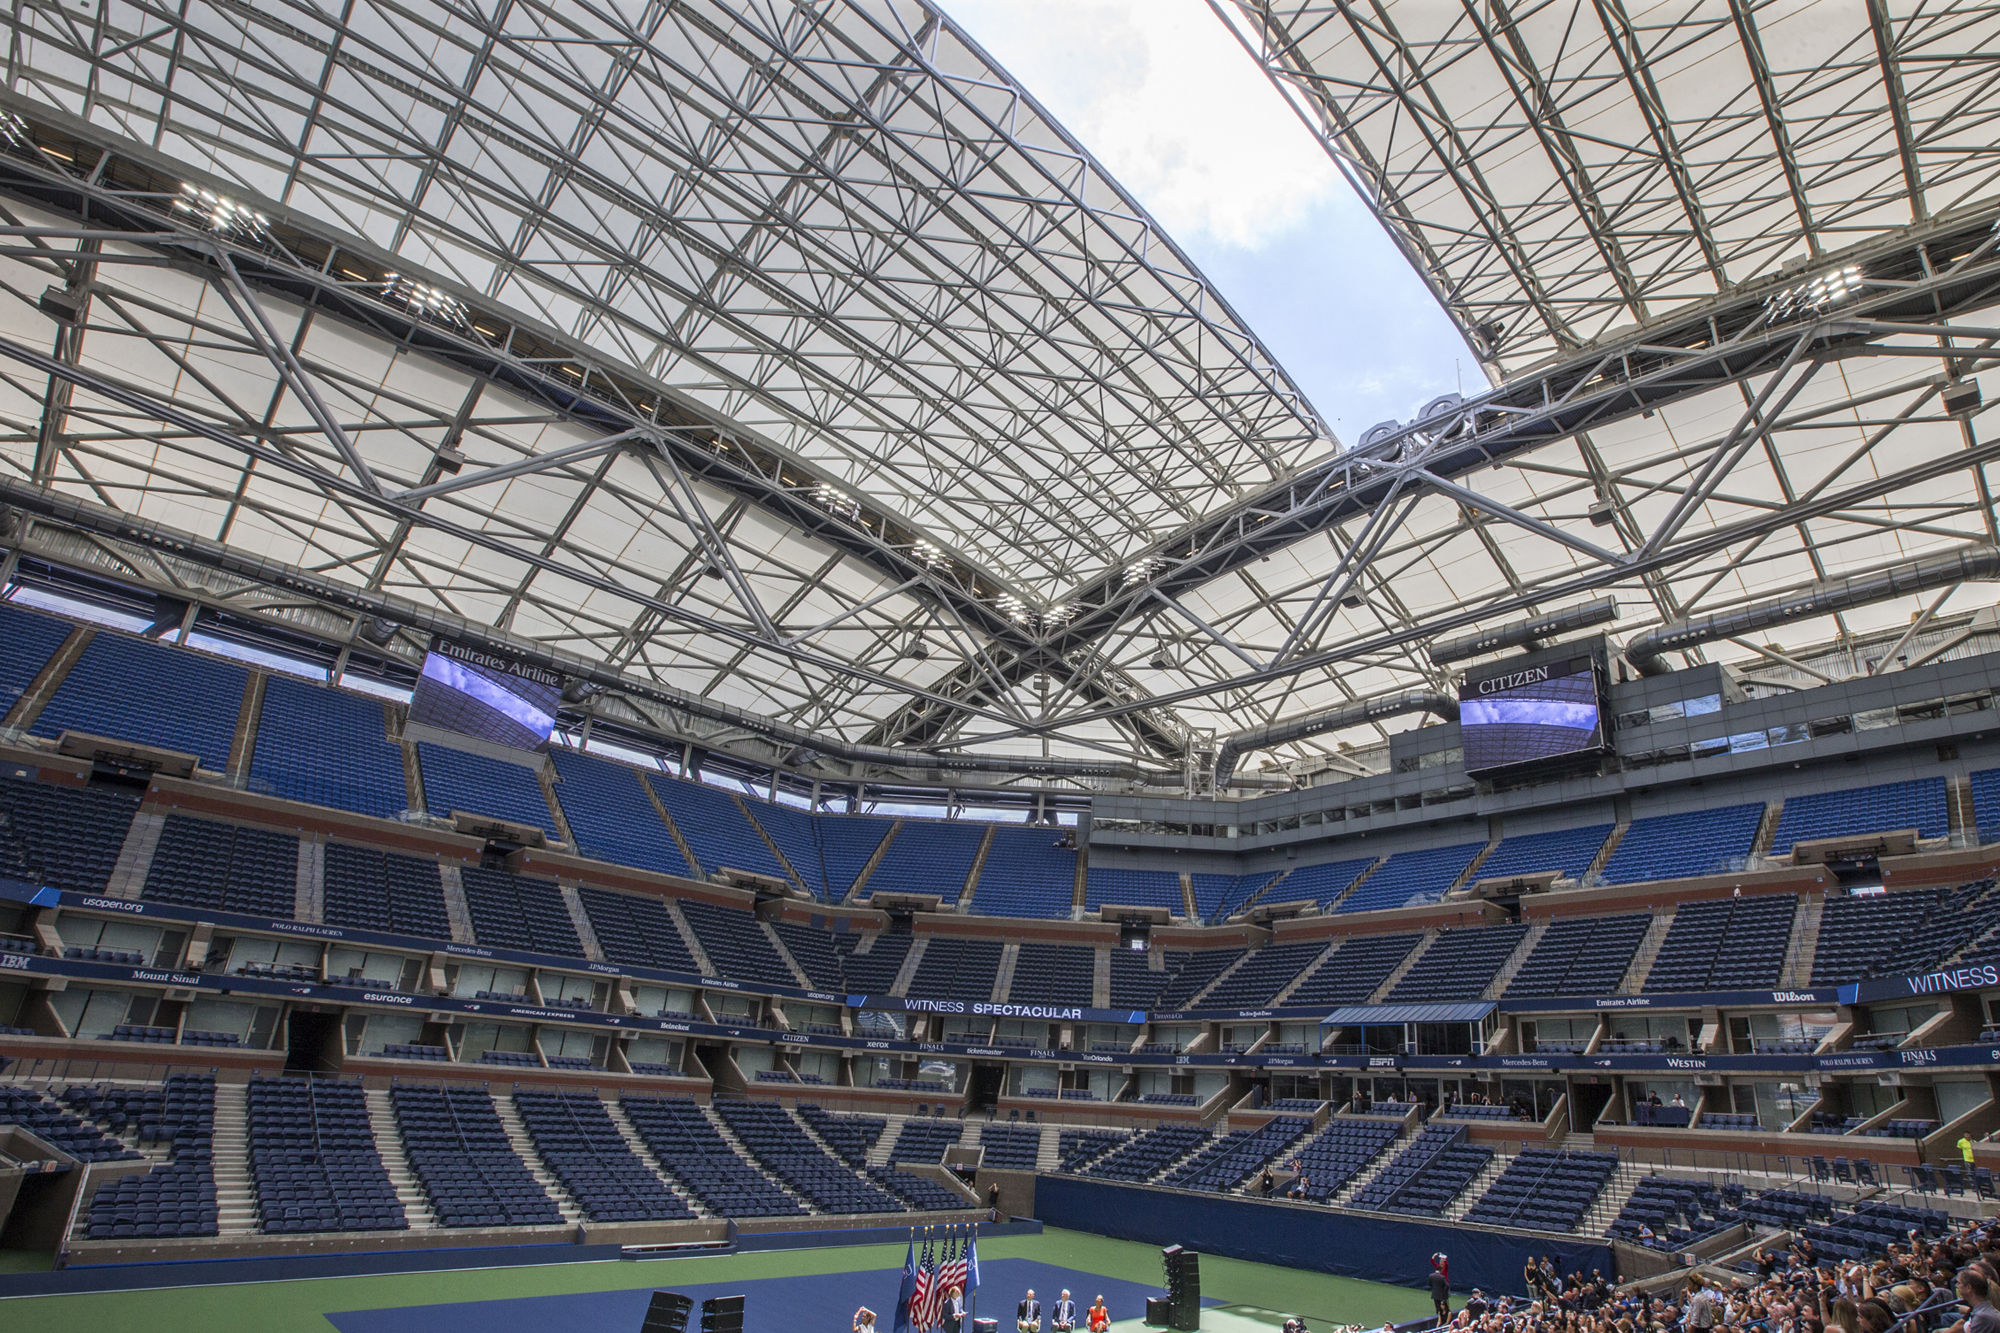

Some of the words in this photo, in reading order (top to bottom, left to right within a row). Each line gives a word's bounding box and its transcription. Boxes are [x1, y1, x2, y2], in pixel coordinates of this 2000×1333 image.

[438, 640, 506, 670] Emirates
[508, 662, 559, 686] Airline
[1478, 666, 1549, 694] CITIZEN
[83, 896, 143, 913] usopen.org
[271, 922, 292, 930] POLO
[292, 925, 315, 933] RALPH
[316, 928, 343, 937] LAUREN
[445, 944, 492, 956] Mercedes-Benz
[0, 954, 31, 970] IBM
[132, 970, 168, 982] Mount
[171, 974, 201, 985] Sinai
[1908, 965, 1999, 993] WITNESS
[701, 978, 721, 987] Emirates
[722, 980, 740, 988] Airline
[363, 993, 413, 1004] esurance
[807, 991, 834, 1001] usopen.org
[1772, 991, 1816, 1002] Wilson
[1596, 999, 1626, 1007] Emirates
[1626, 998, 1650, 1006] Airline
[511, 1007, 546, 1016] AMERICAN
[547, 1011, 575, 1019] EXPRESS
[904, 999, 964, 1013] WITNESS
[973, 1003, 1081, 1019] SPECTACULAR
[661, 1022, 690, 1031] Heineken
[782, 1034, 810, 1043] CITIZEN
[866, 1041, 890, 1049] xerox
[919, 1043, 944, 1051] FINALS
[966, 1047, 1003, 1056] ticketmaster
[1030, 1050, 1055, 1058] FINALS
[1900, 1050, 1937, 1063] FINALS
[1175, 1056, 1190, 1065] IBM
[1369, 1057, 1395, 1067] ESPN
[1502, 1059, 1548, 1067] Mercedes-Benz
[1819, 1059, 1834, 1067] POLO
[1834, 1058, 1852, 1066] RALPH
[1852, 1057, 1874, 1065] LAUREN
